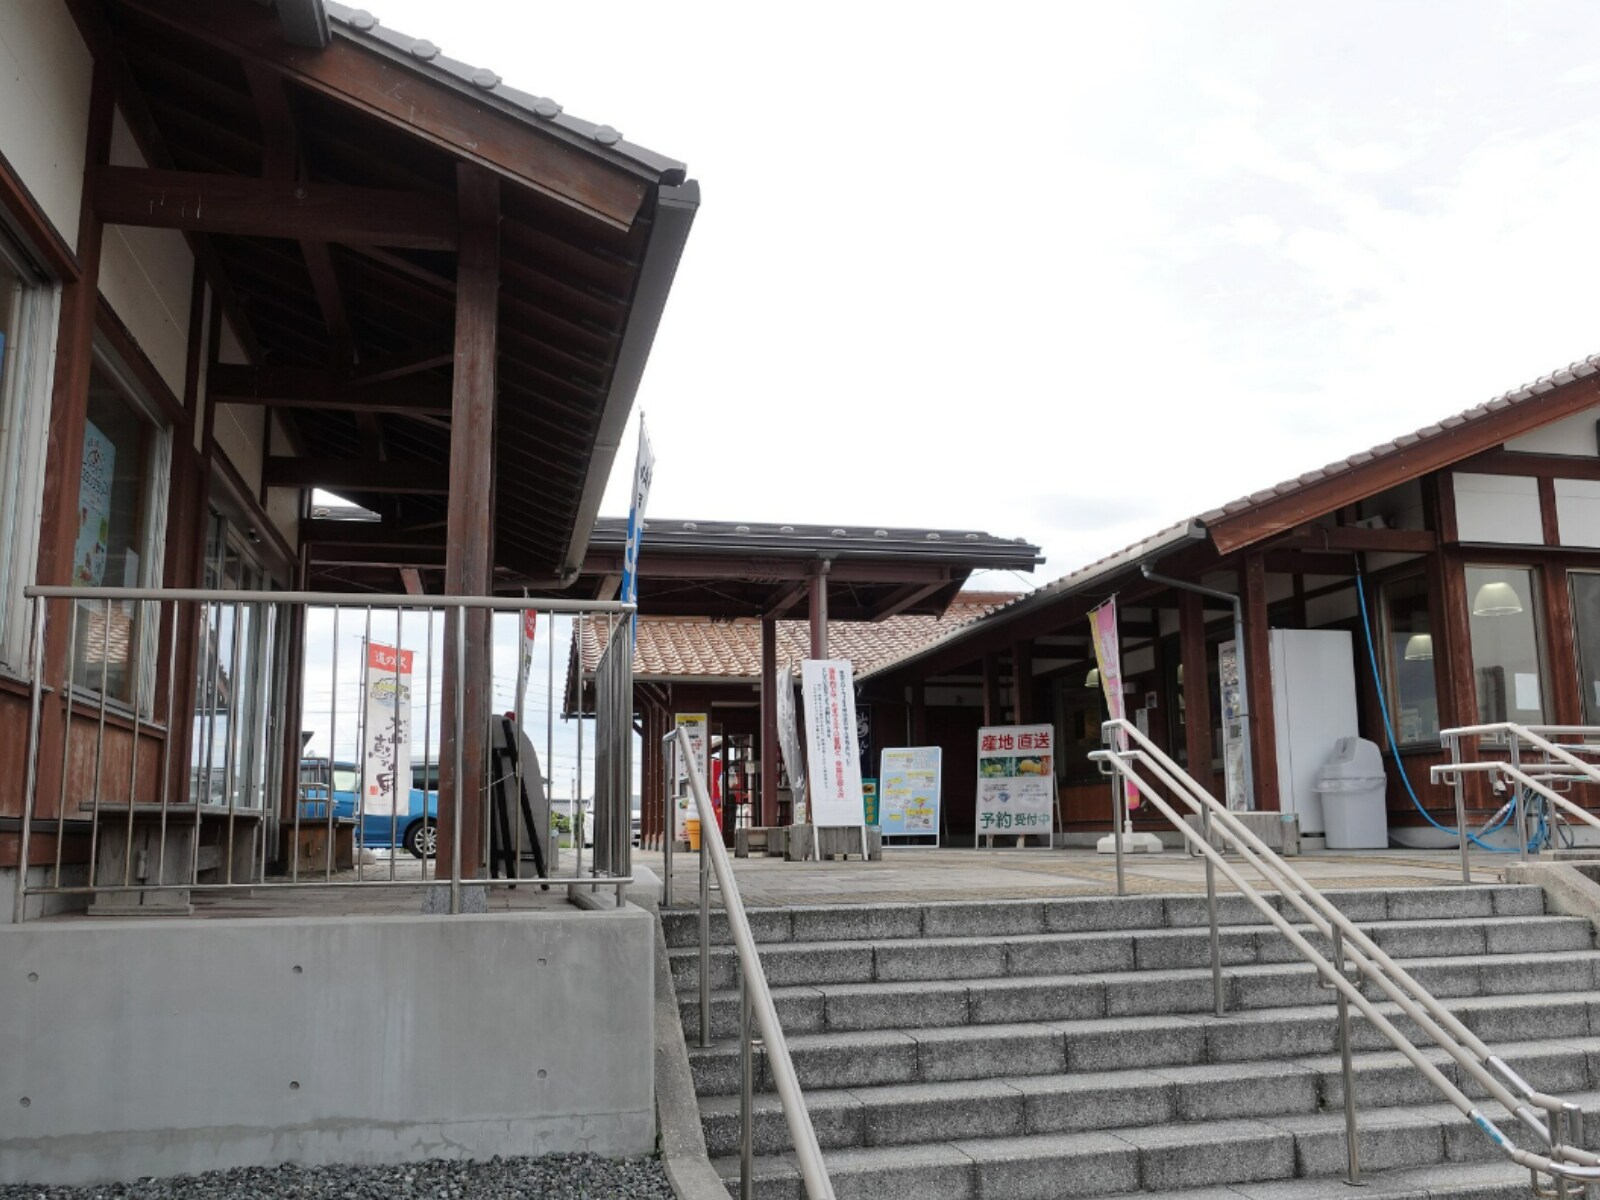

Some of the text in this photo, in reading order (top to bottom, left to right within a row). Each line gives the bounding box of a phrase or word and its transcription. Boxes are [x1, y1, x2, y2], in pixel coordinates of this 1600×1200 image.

[982, 732, 1051, 751] 産地直送
[981, 811, 1050, 828] 予約受付中
